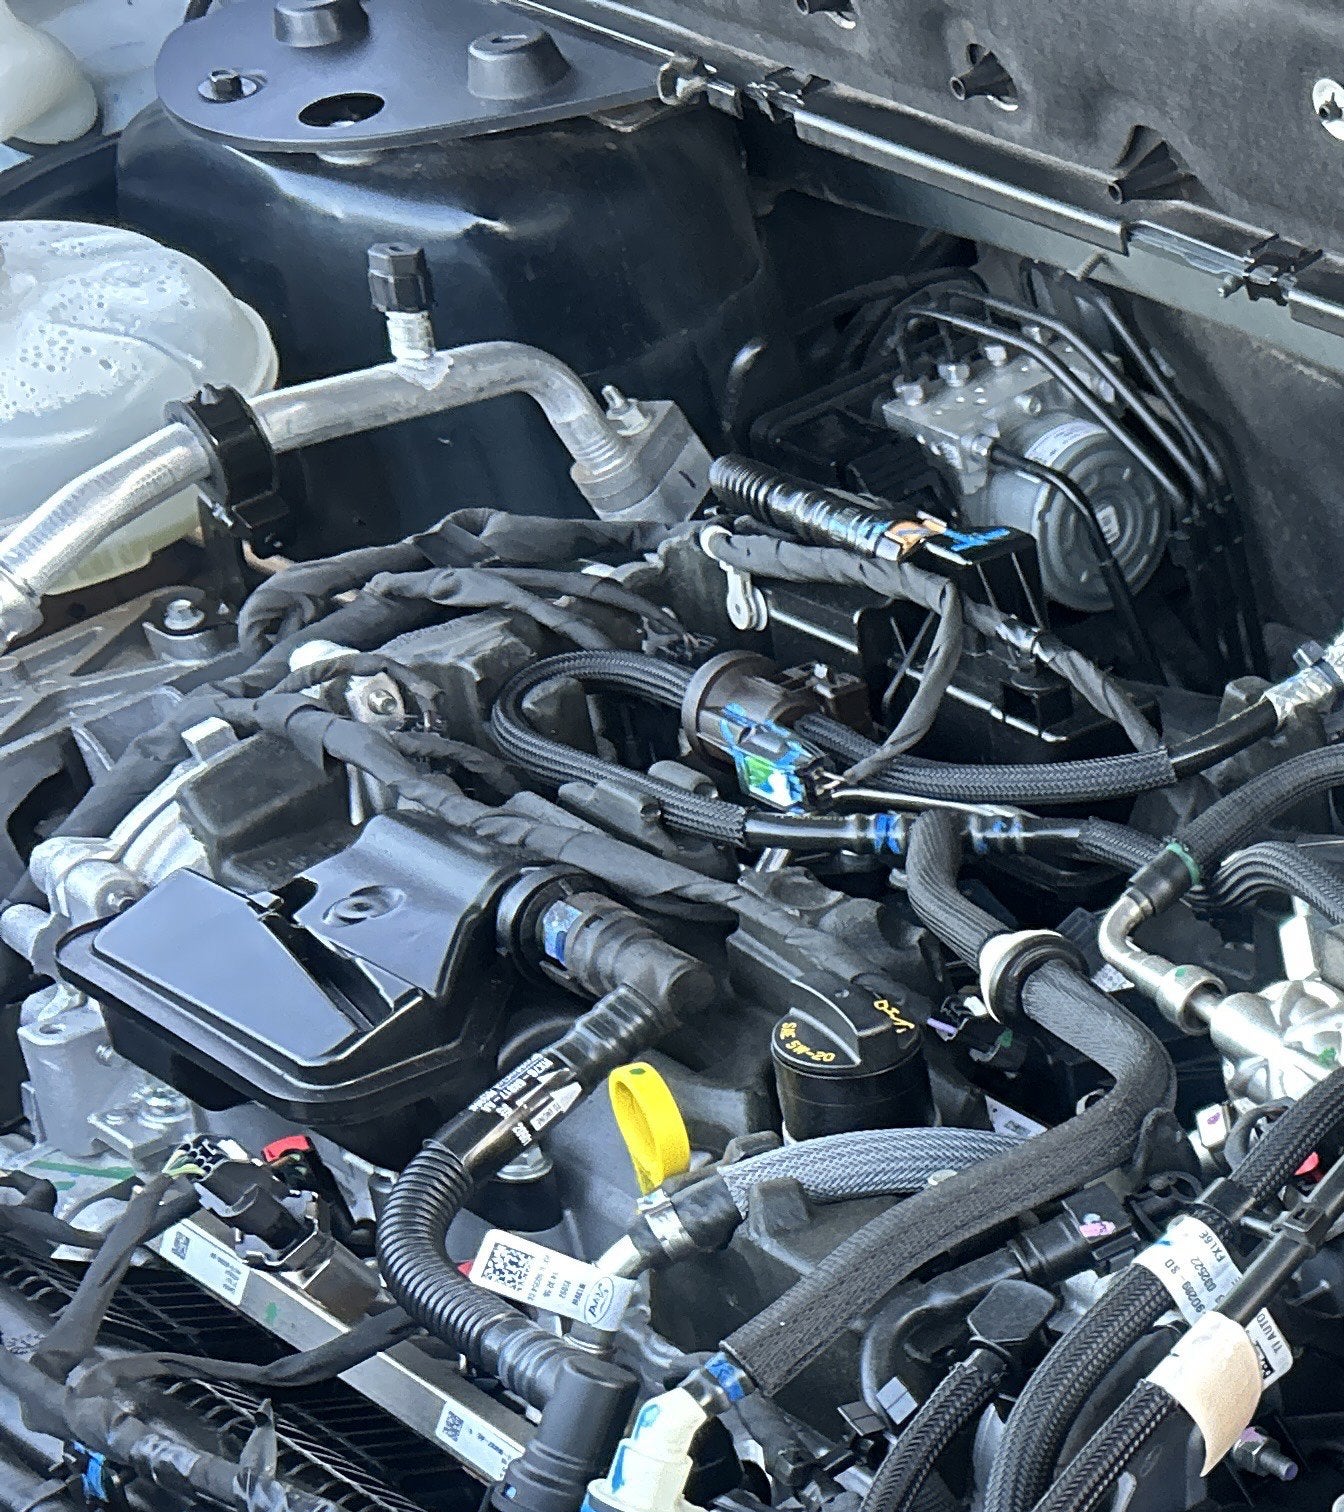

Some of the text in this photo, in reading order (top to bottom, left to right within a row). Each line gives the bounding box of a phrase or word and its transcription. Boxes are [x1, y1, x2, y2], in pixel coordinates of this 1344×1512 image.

[780, 1022, 836, 1063] SAE 5W-20
[1271, 1341, 1282, 1354] TI
